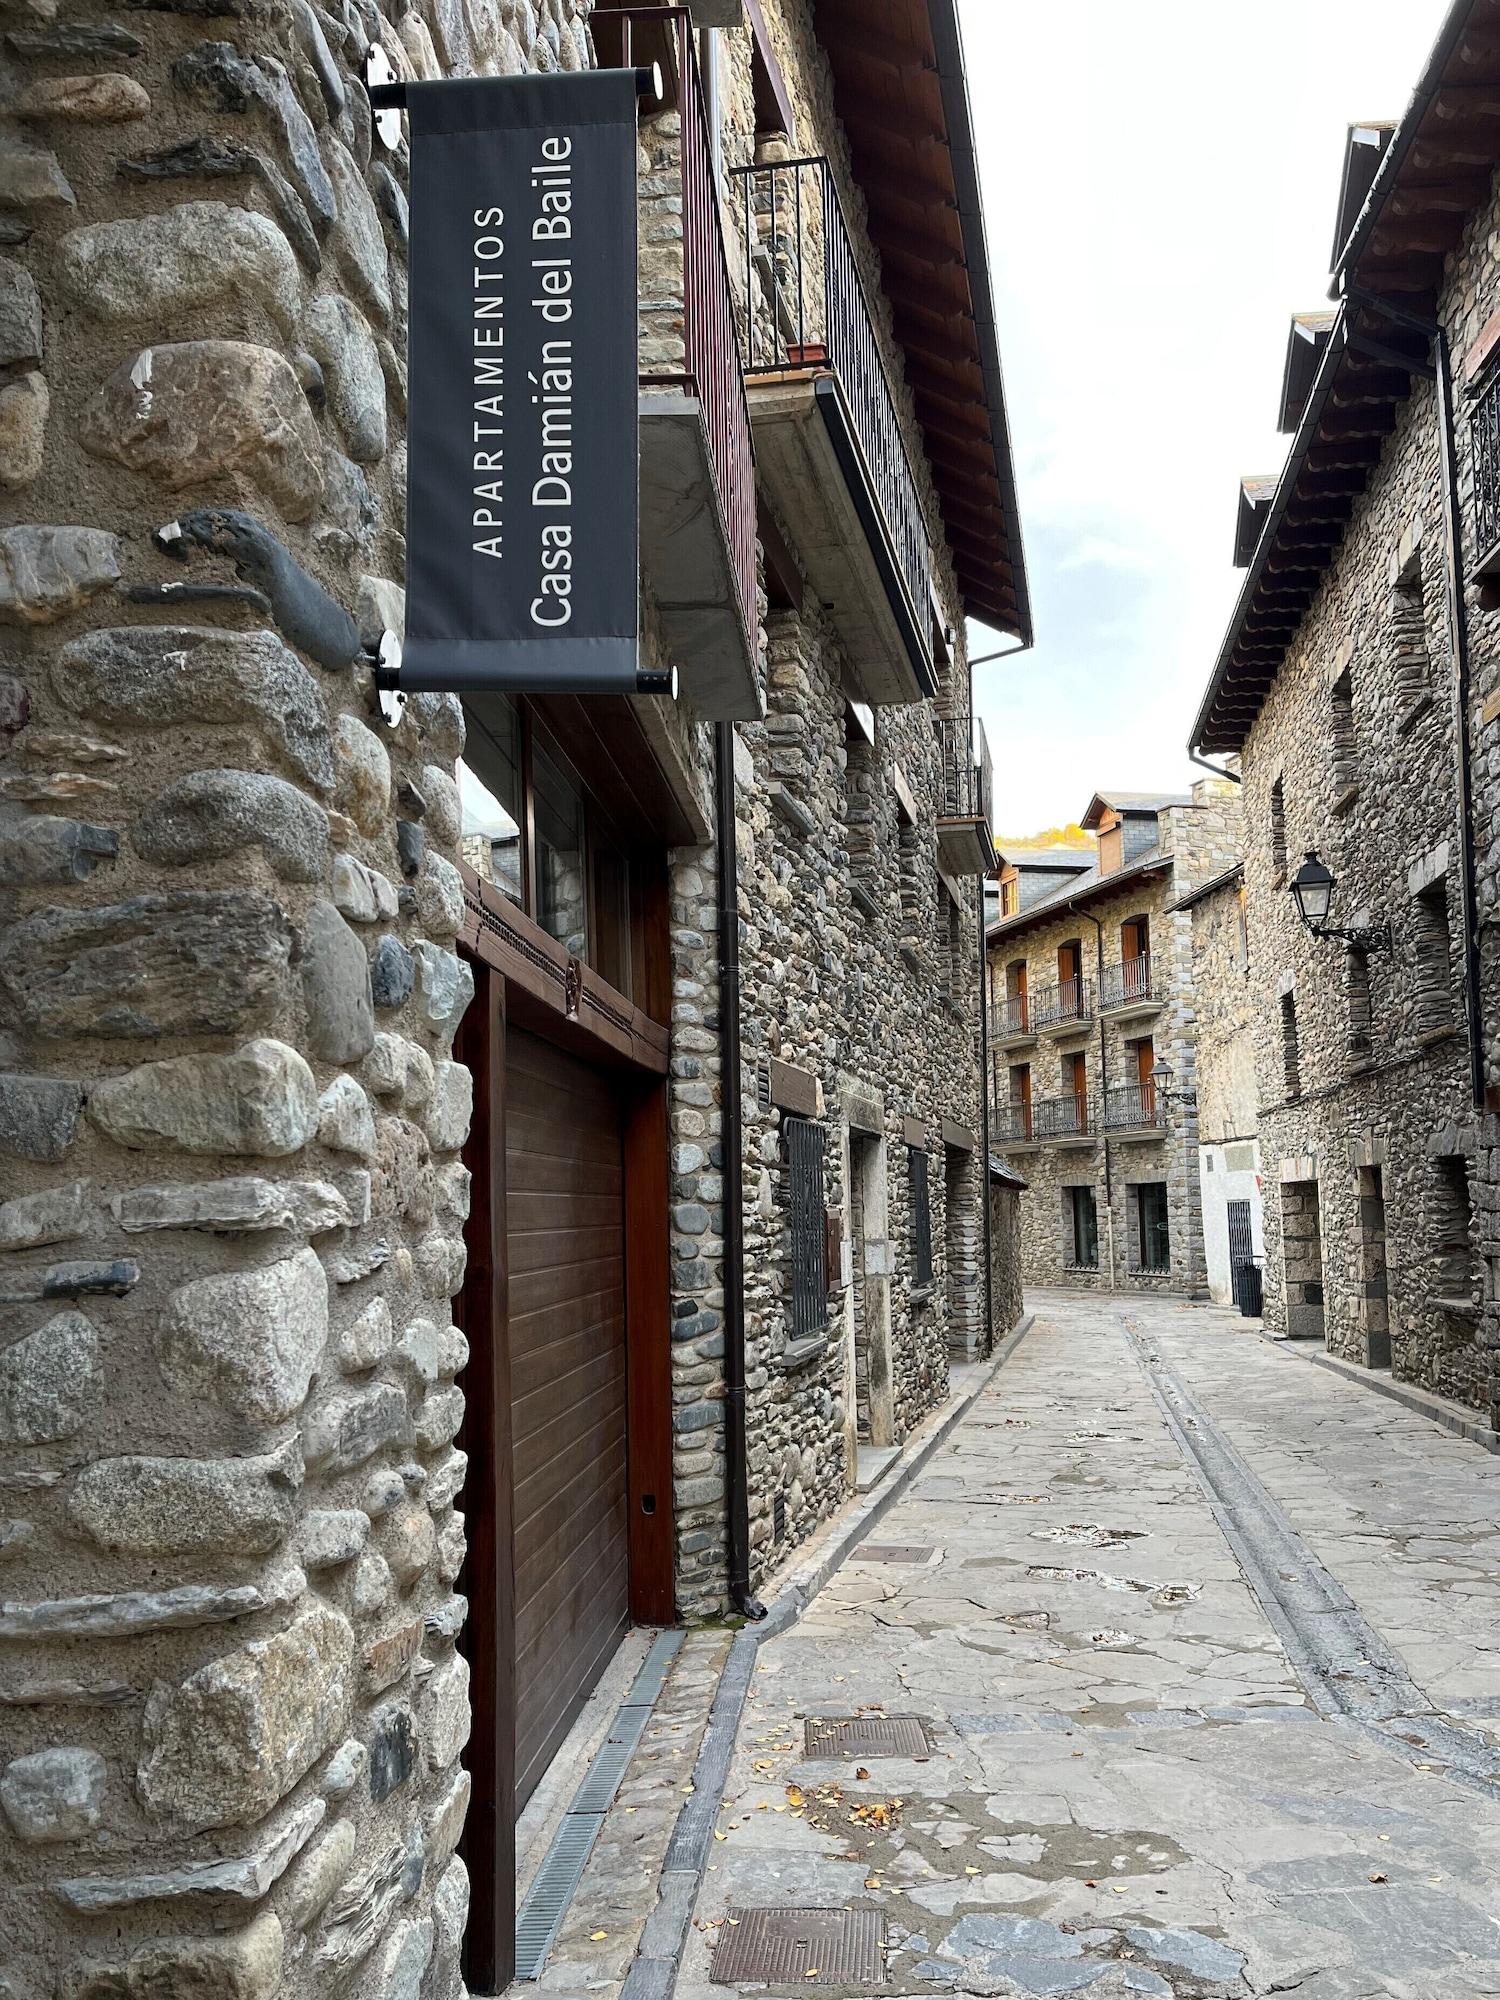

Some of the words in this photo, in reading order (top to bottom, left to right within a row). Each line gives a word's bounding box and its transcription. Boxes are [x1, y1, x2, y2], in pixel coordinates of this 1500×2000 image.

[531, 136, 572, 241] Baile
[531, 259, 573, 323] del
[472, 207, 504, 559] APARTAMENTOS
[527, 340, 573, 506] Damián
[530, 525, 573, 627] Casa
